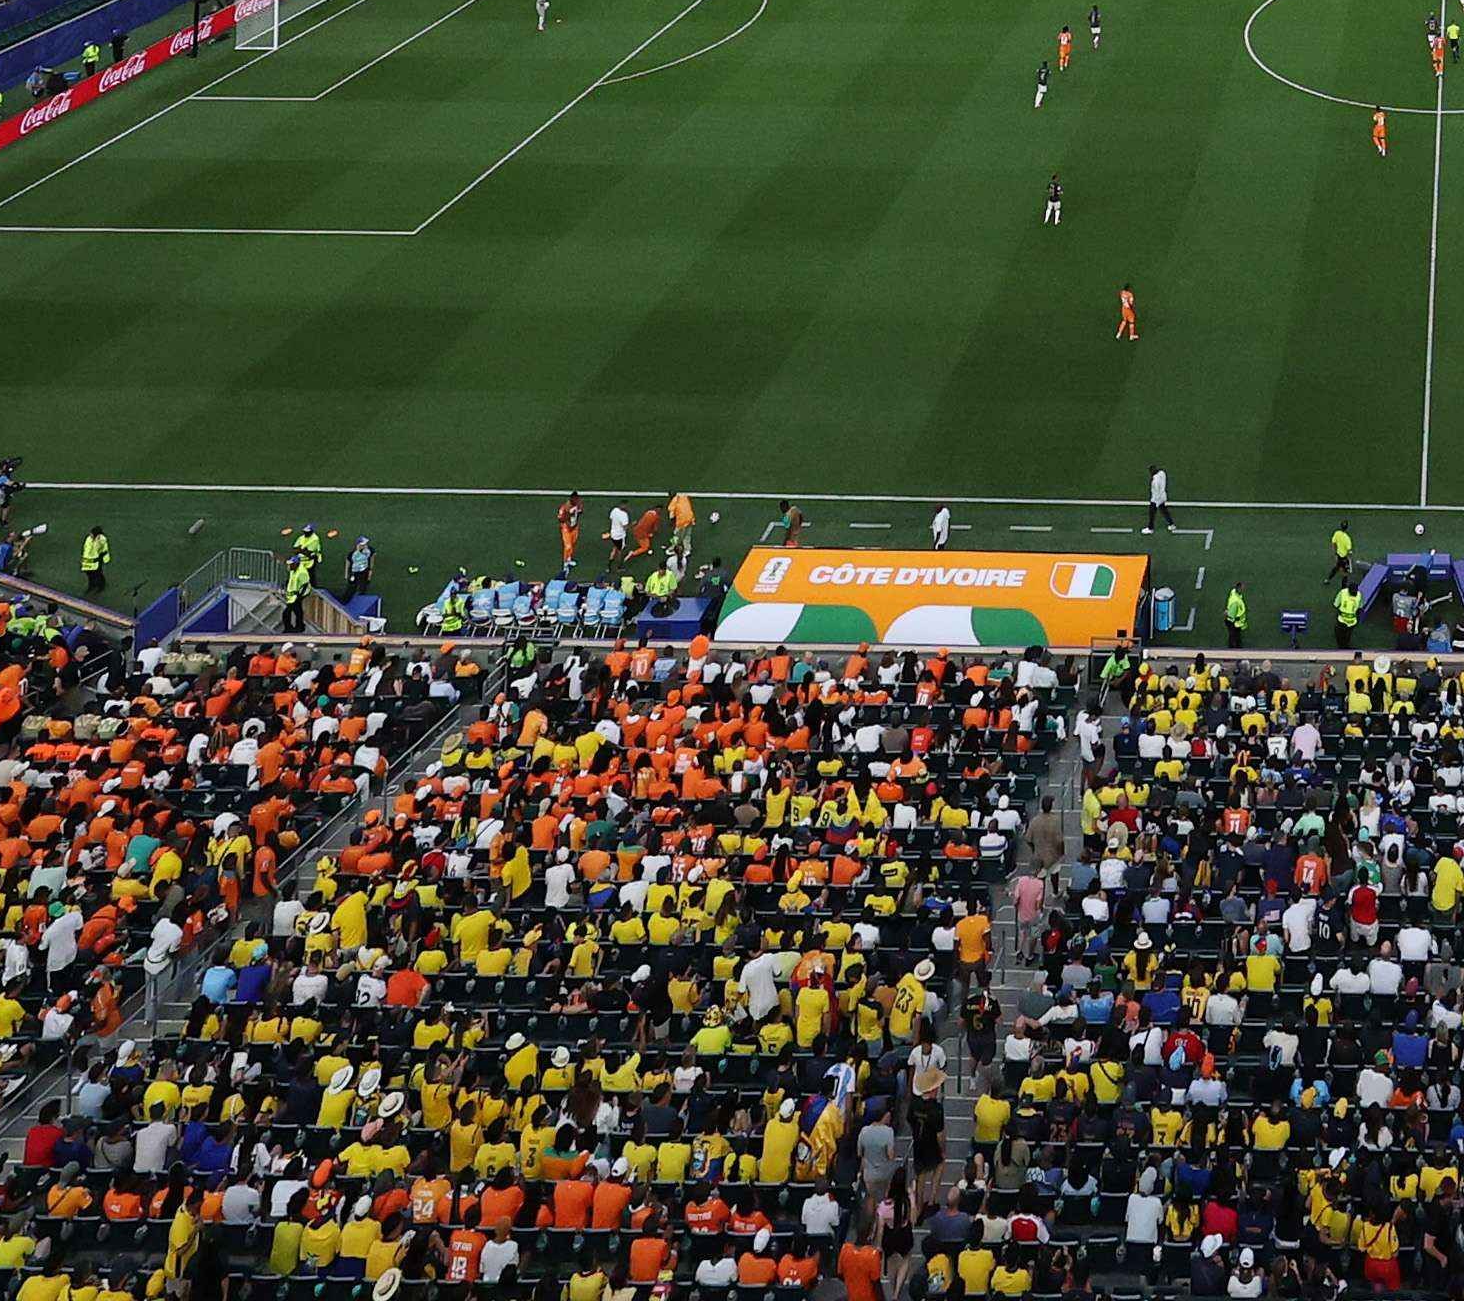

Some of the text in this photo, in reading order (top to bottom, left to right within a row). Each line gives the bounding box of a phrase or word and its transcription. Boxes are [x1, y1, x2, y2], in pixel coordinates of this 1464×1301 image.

[98, 50, 148, 93] Coca-Cola
[20, 89, 73, 135] Coca-Cola
[808, 563, 1028, 588] CÔTE D'IVOIRE
[636, 659, 649, 677] 10
[1229, 819, 1240, 833] 11
[1318, 920, 1331, 939] 10
[895, 987, 916, 1012] 23
[527, 1147, 536, 1167] 3
[411, 1199, 436, 1218] 24
